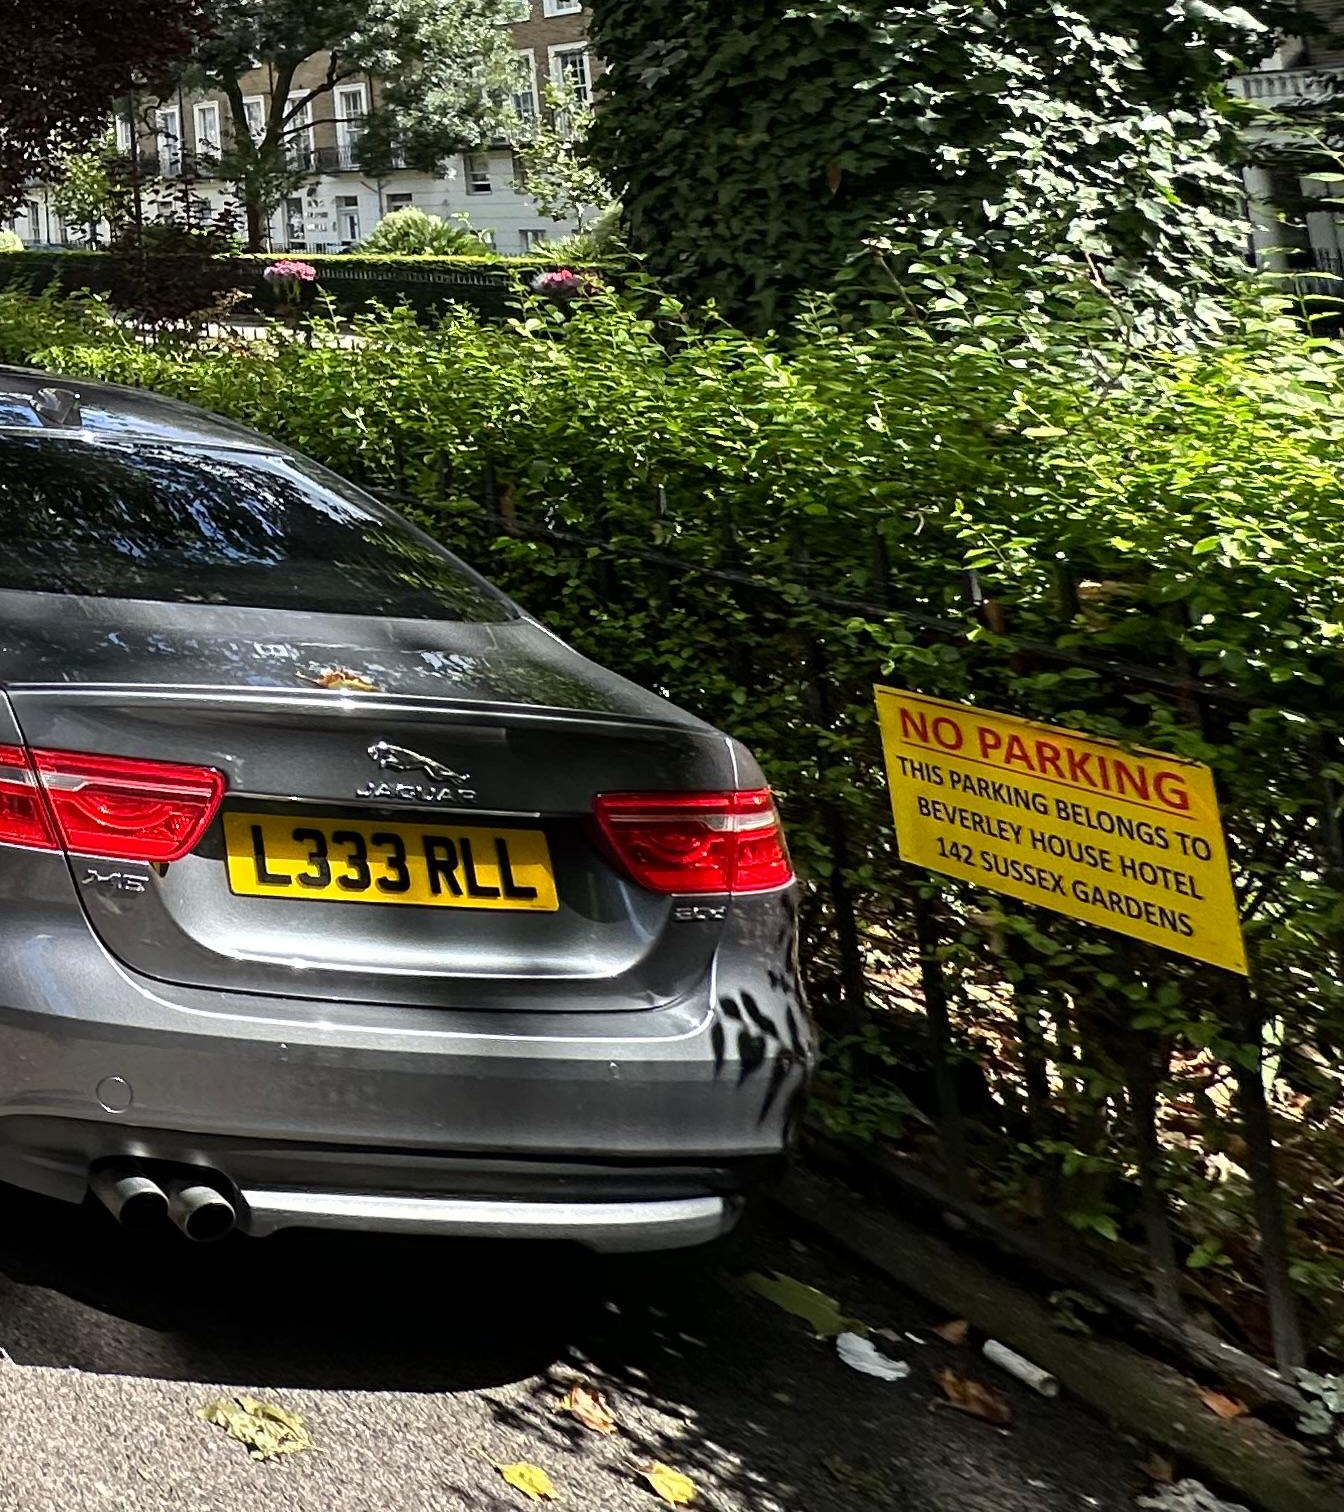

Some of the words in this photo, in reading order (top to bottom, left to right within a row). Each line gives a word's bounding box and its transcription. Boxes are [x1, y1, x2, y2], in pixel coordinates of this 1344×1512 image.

[356, 782, 479, 803] JAGUAR
[896, 755, 945, 787] THIS
[949, 771, 1050, 817] PARKING
[1055, 798, 1170, 851] BELONGS
[1175, 831, 1213, 862] TO
[899, 707, 962, 752] NO
[978, 726, 1191, 811] PARKING
[250, 824, 412, 893] L333
[422, 834, 539, 900] RLL
[918, 795, 1023, 845] BEVERLEY
[1031, 829, 1112, 873] HOUSE
[1119, 855, 1205, 901] HOTEL
[936, 836, 977, 868] 142
[979, 851, 1067, 898] SUSSEX
[1071, 879, 1195, 938] GARDENS
